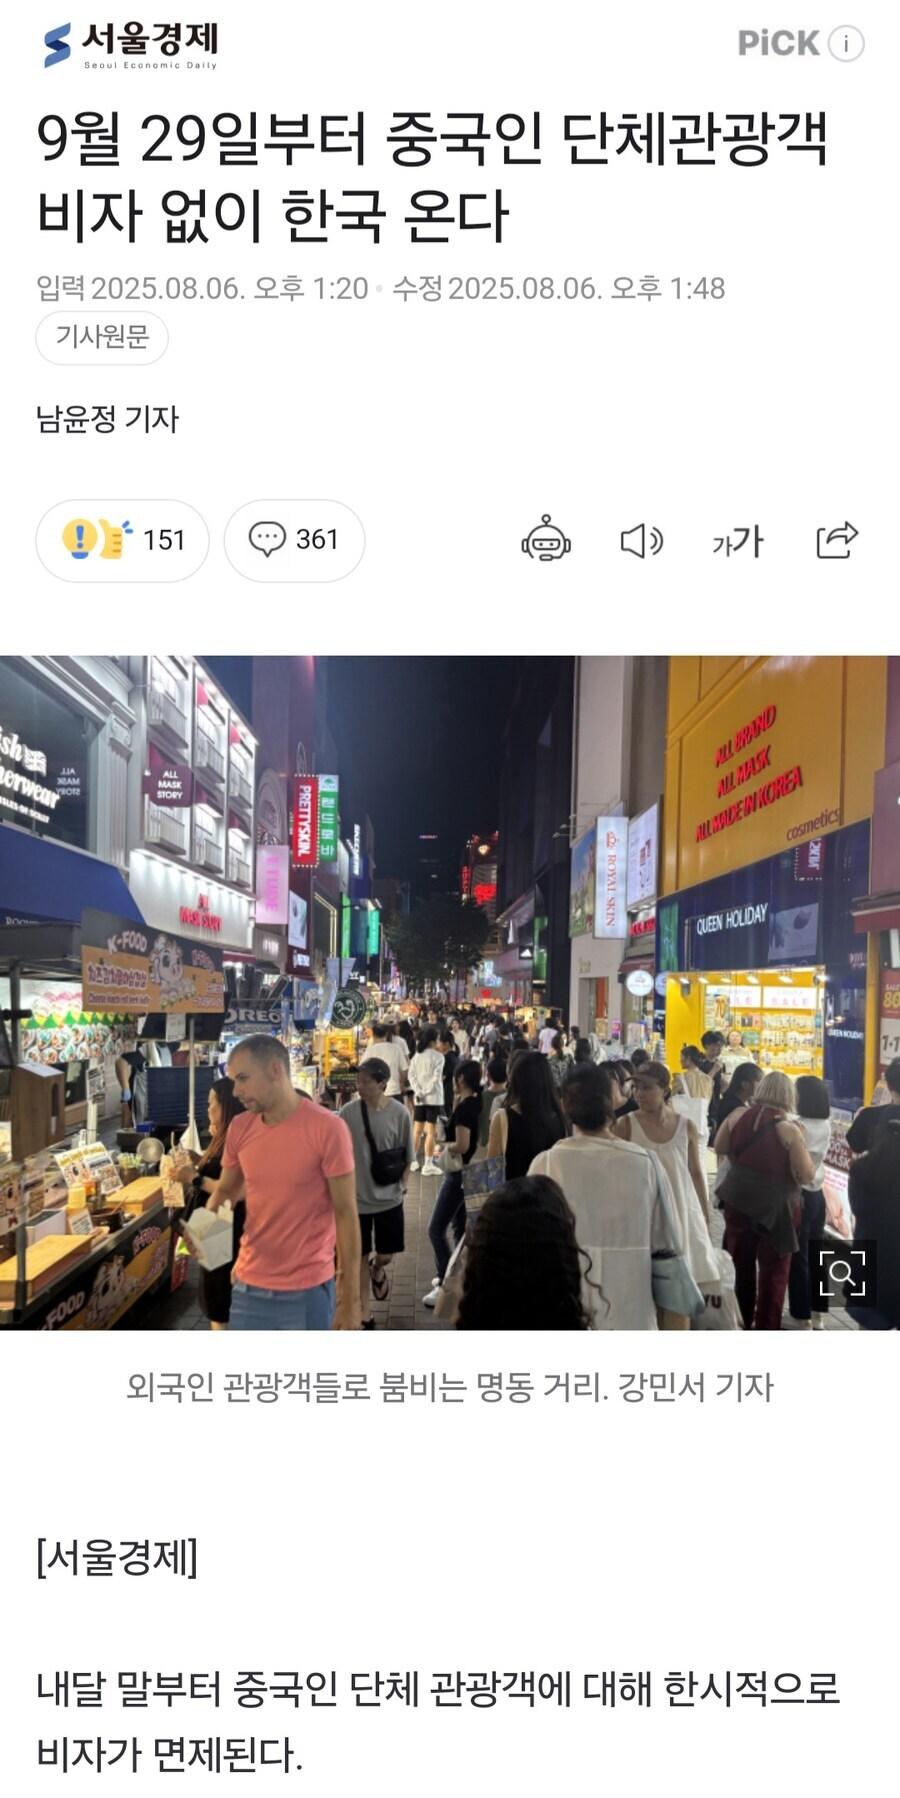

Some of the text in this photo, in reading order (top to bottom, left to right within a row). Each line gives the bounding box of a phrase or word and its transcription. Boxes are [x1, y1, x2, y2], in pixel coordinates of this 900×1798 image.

[714, 704, 777, 768] ALL BRAND
[157, 780, 182, 789] MASK
[162, 770, 178, 779] ALL
[717, 744, 772, 799] ALL MASK
[156, 790, 183, 800] STORY
[695, 766, 804, 843] ALL MADE IN KOREA
[786, 808, 840, 842] cosmetics
[606, 855, 617, 927] ROYAL SKIN
[696, 902, 768, 936] QUEEN HOLIDAY
